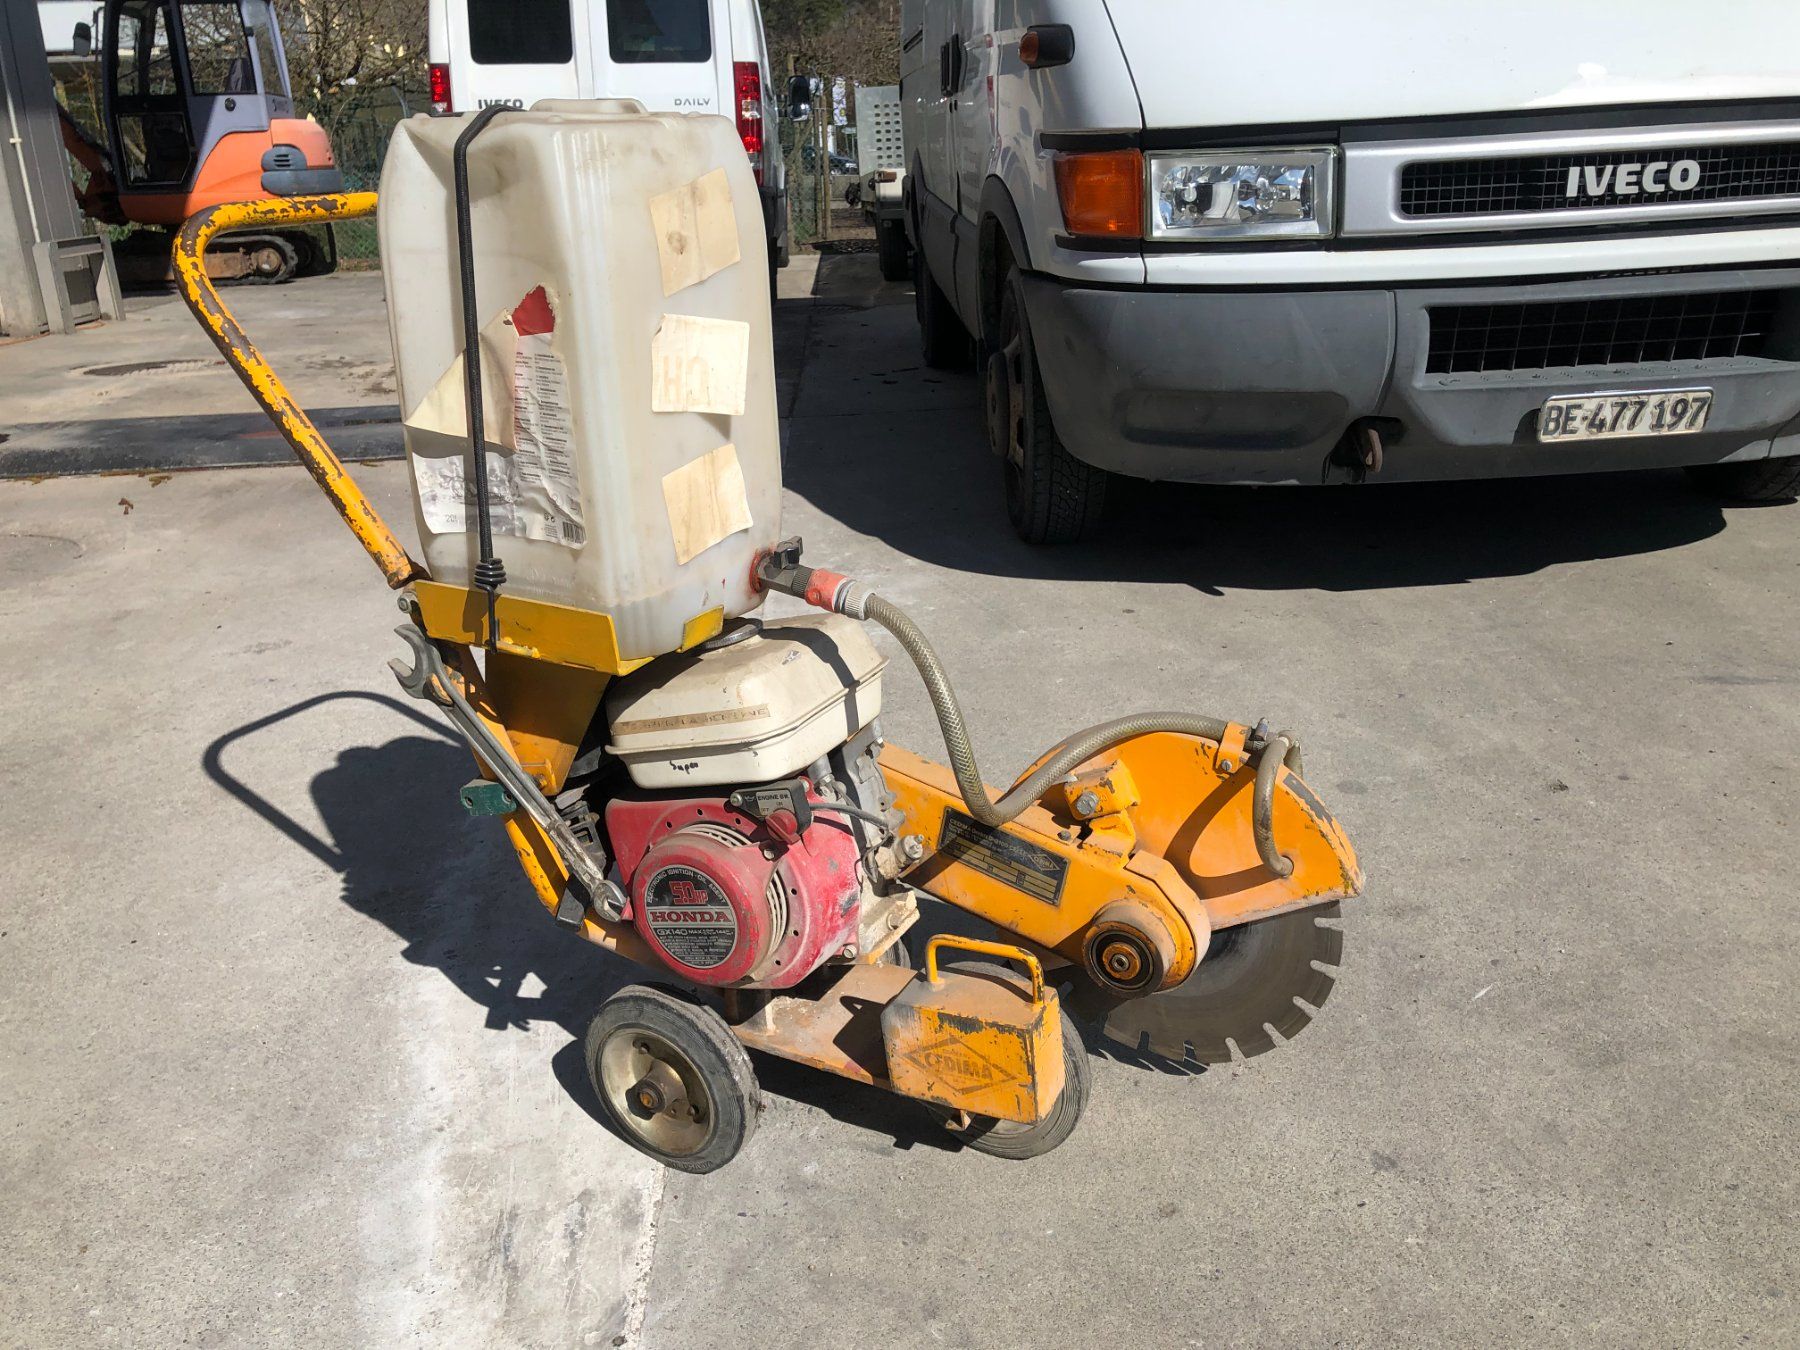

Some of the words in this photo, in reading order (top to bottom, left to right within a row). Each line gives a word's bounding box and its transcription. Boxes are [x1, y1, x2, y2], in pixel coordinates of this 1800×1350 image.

[478, 99, 523, 109] IVECO
[674, 98, 711, 106] DAILY
[1566, 159, 1700, 197] IVECO
[1651, 397, 1711, 431] 197
[647, 872, 668, 904] ELECTRONIC
[667, 868, 694, 879] IGNITION
[650, 911, 732, 923] HONDA
[657, 928, 688, 936] GX140
